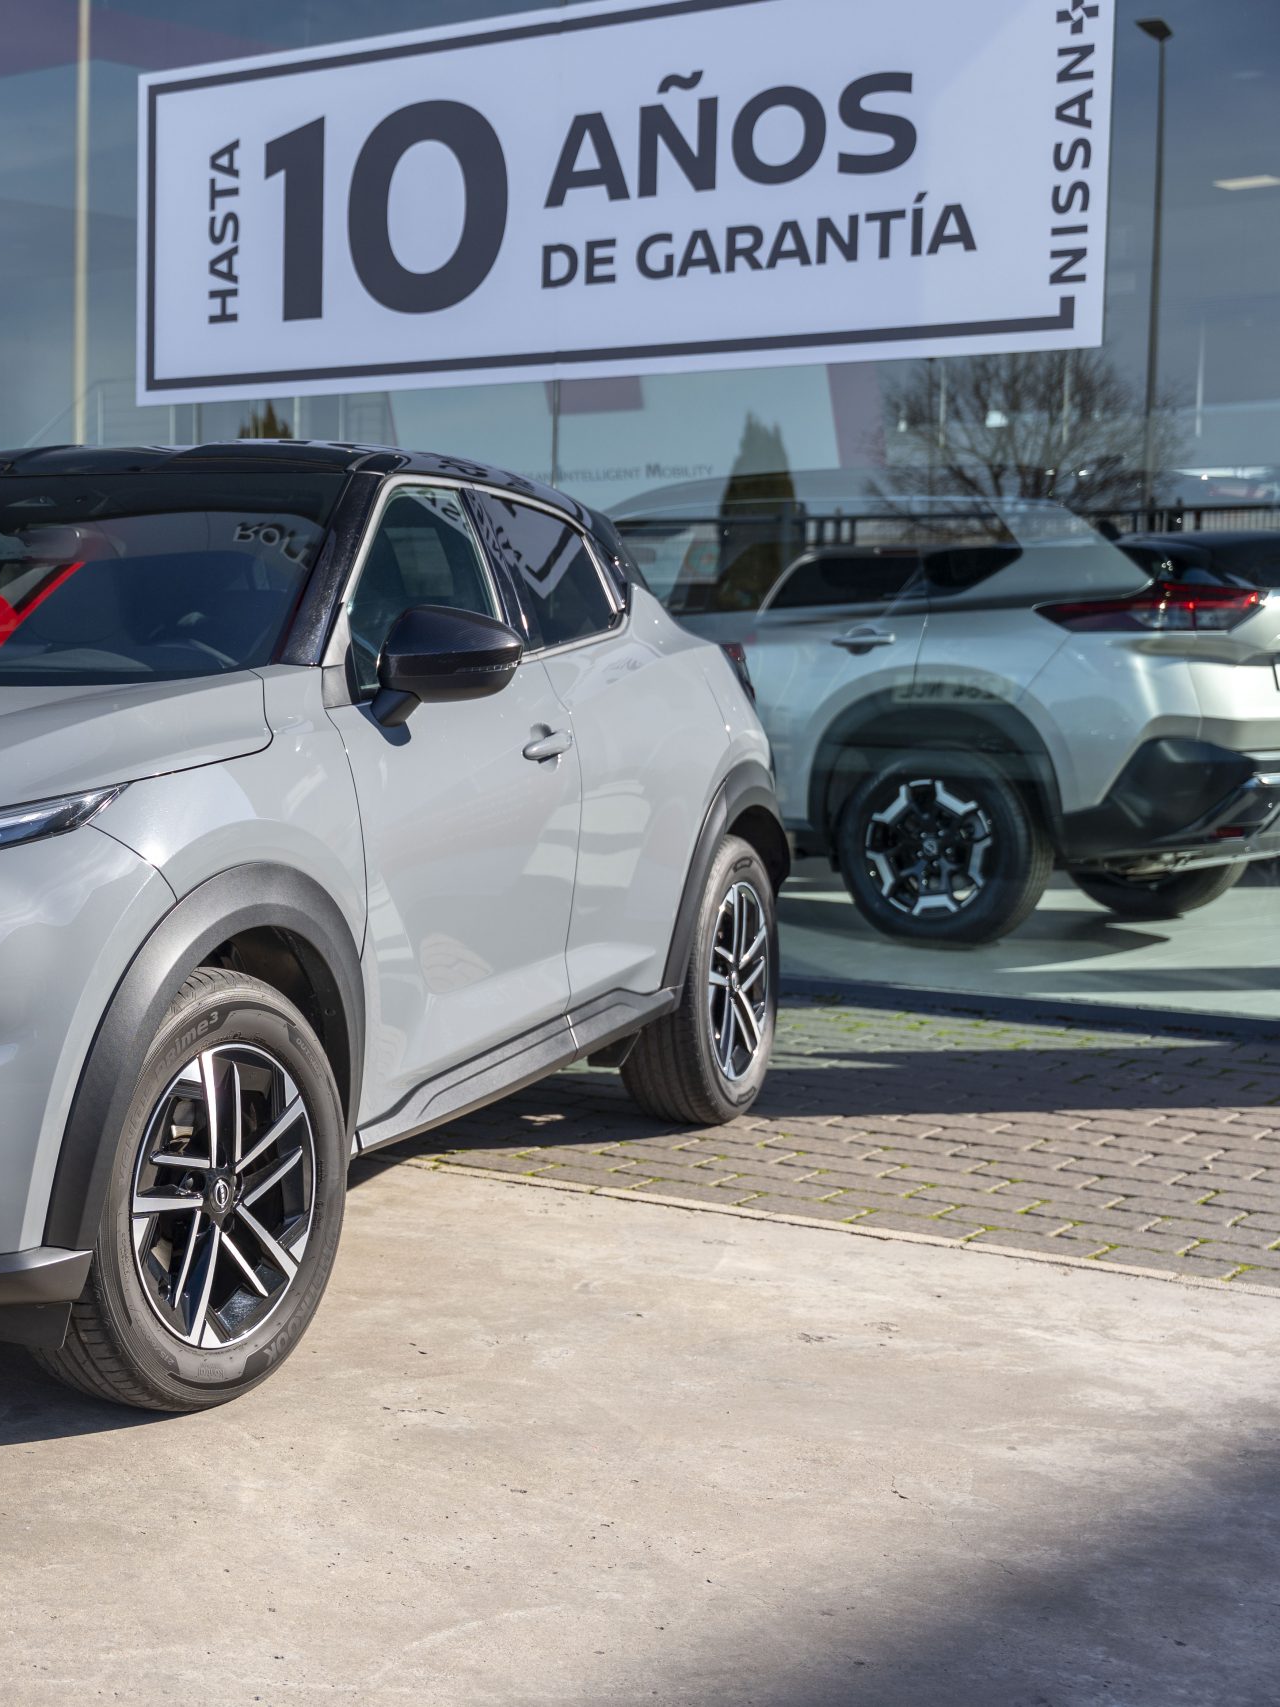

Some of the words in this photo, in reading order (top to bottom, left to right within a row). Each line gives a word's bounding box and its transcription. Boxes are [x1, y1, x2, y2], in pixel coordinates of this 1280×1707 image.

[208, 138, 240, 325] HASTA
[264, 99, 509, 323] 10
[543, 70, 918, 209] AÑOS
[1049, 43, 1095, 285] NISSAN
[541, 238, 617, 290] DE
[635, 191, 977, 280] GARANTÍA
